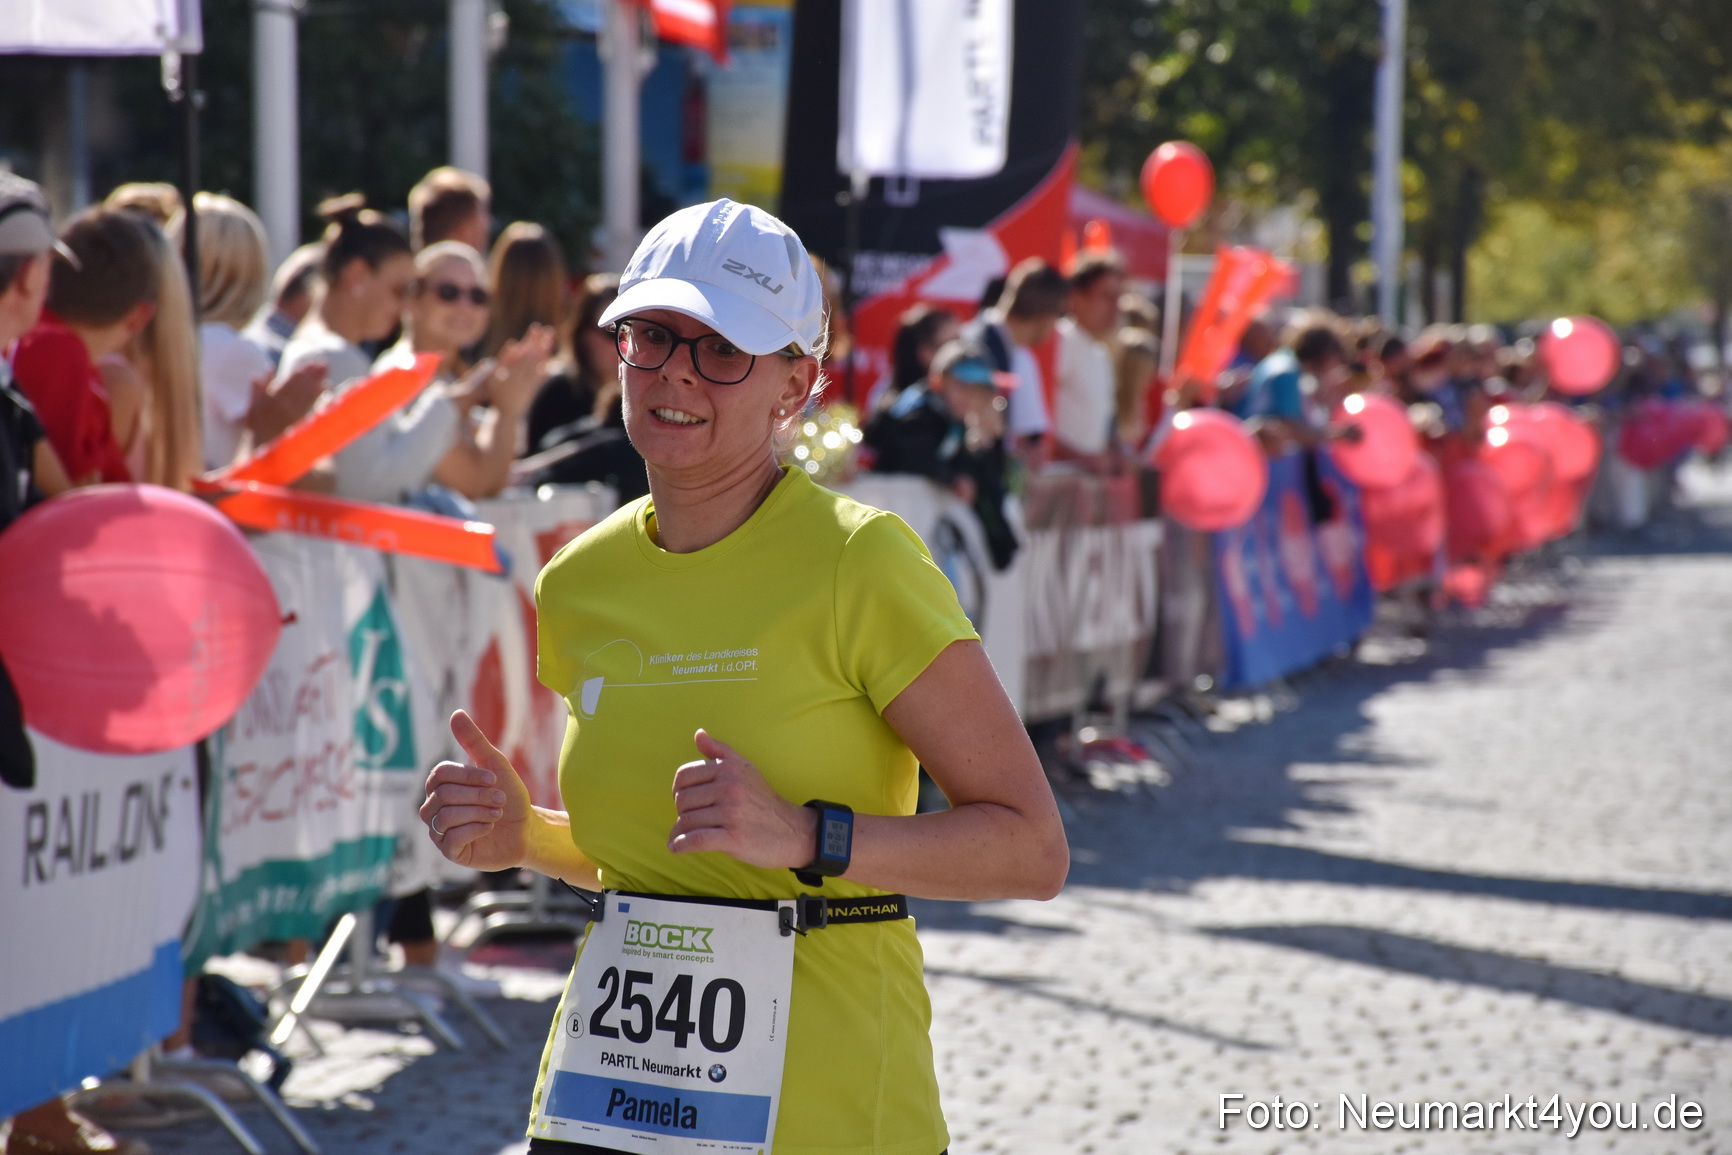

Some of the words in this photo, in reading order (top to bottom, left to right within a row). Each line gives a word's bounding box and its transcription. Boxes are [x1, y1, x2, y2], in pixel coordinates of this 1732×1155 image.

[721, 258, 784, 295] 2XU
[649, 653, 683, 666] Kliniken
[686, 651, 702, 662] des
[703, 647, 759, 661] Landkreises
[672, 663, 719, 676] Neumarkt
[721, 660, 758, 672] i.d.OPf.
[623, 919, 715, 954] BOCK
[622, 946, 641, 956] inspired
[642, 948, 651, 959] by
[652, 951, 674, 960] smart
[675, 952, 715, 964] concepts
[589, 965, 746, 1053] 2540
[572, 1019, 579, 1033] B
[600, 1051, 639, 1070] PARTL
[641, 1057, 702, 1079] Neumarkt
[605, 1087, 698, 1130] Pamela
